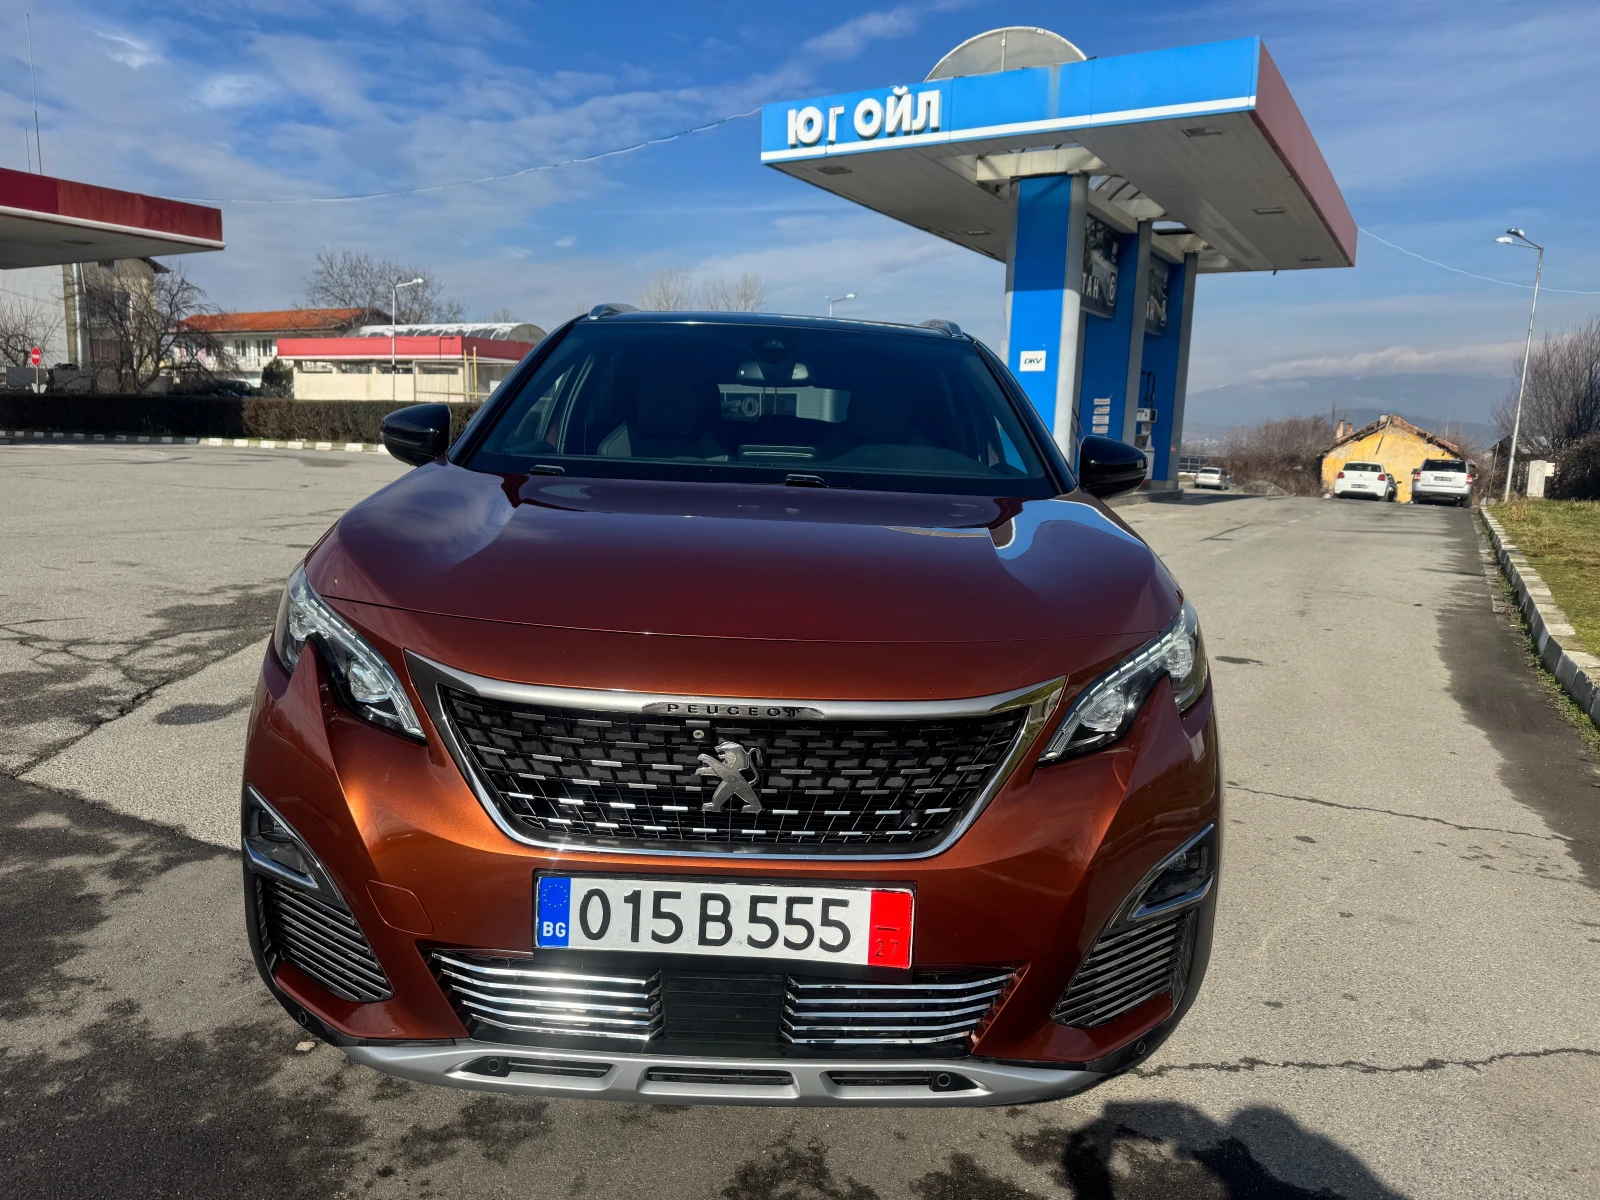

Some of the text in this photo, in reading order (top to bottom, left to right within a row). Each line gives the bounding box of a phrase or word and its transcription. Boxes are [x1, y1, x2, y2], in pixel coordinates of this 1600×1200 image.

[787, 85, 942, 145] ЮГ ОЙЛ
[667, 703, 800, 719] PEUGEOT
[542, 921, 567, 938] BG
[874, 938, 900, 958] 27
